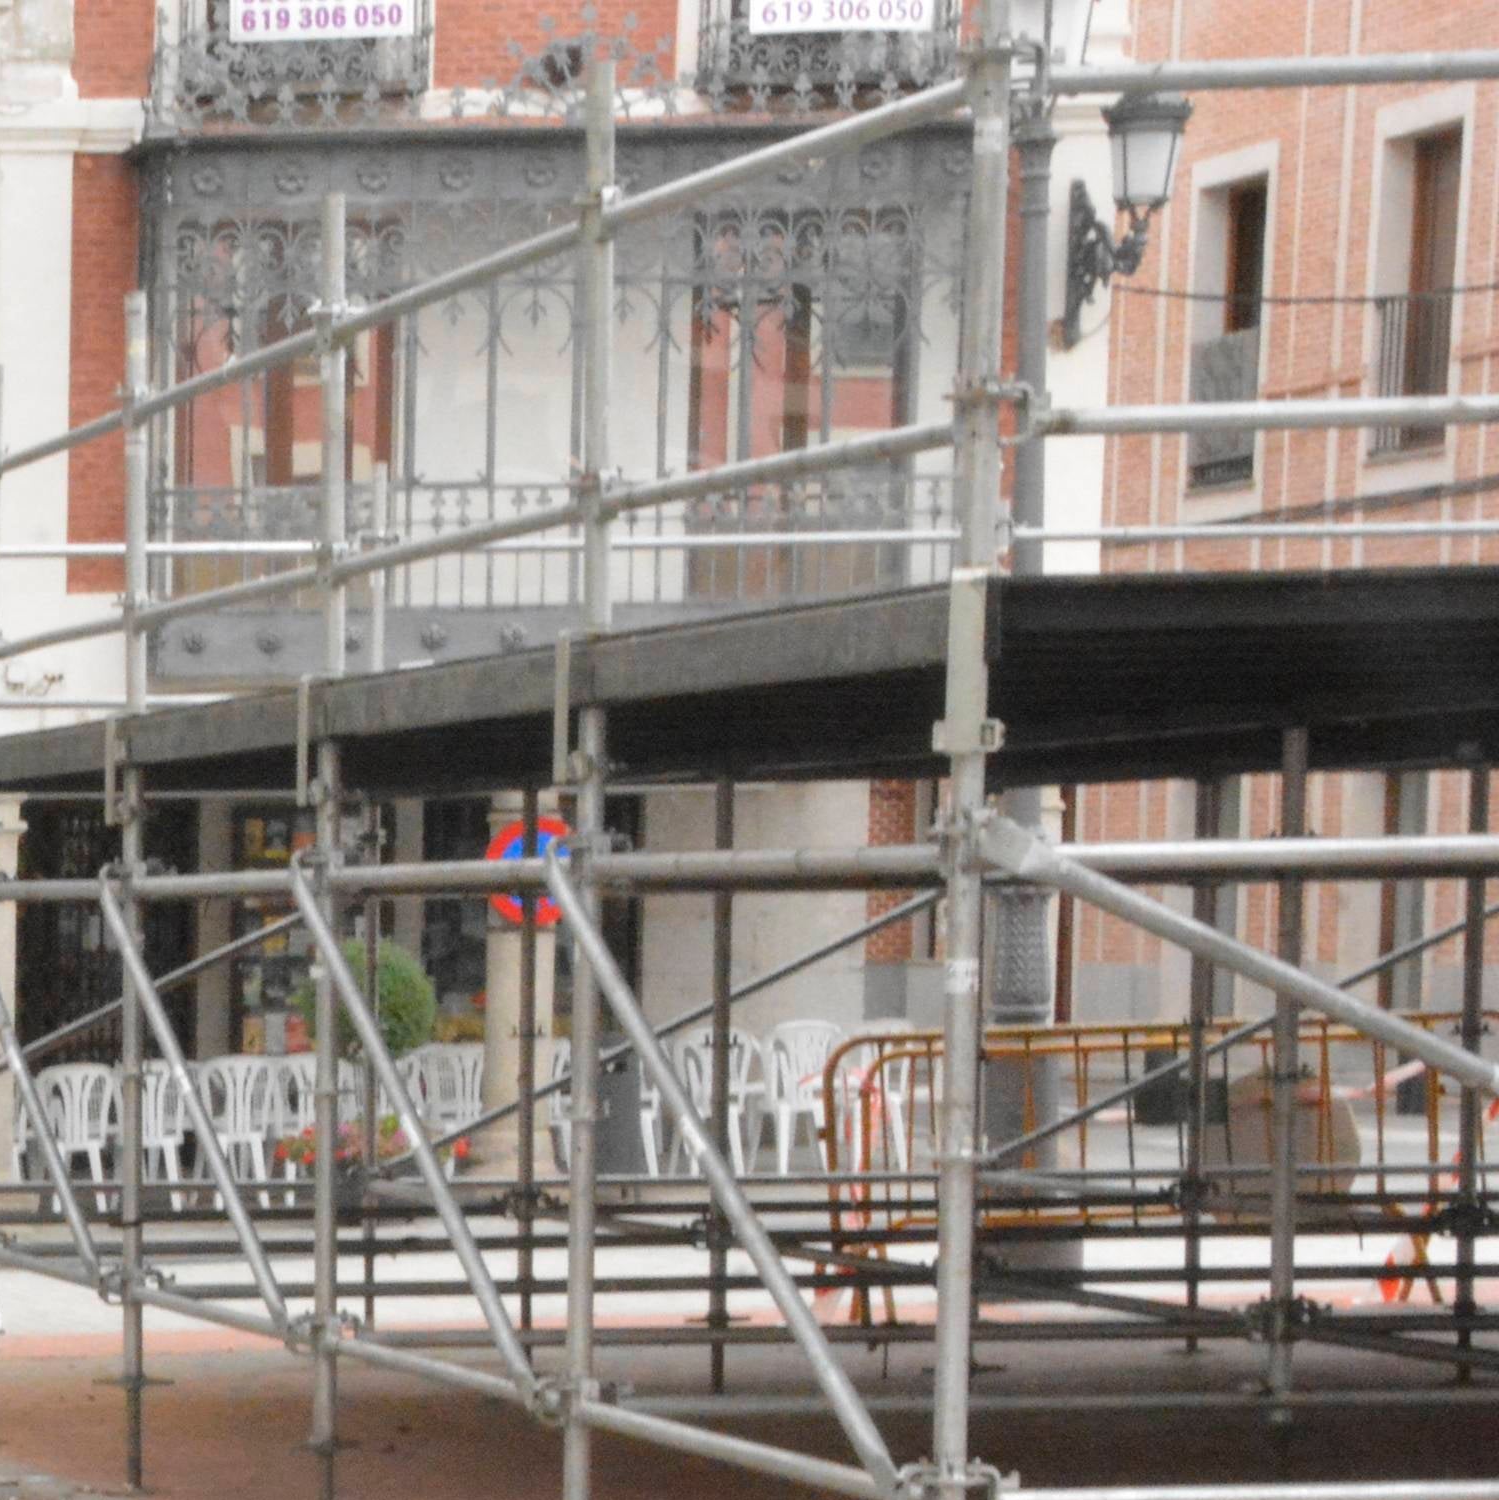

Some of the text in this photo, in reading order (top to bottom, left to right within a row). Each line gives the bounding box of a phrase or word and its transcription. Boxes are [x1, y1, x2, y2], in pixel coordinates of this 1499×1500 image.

[242, 3, 402, 32] 619 306 050
[762, 0, 923, 24] 619 306 050
